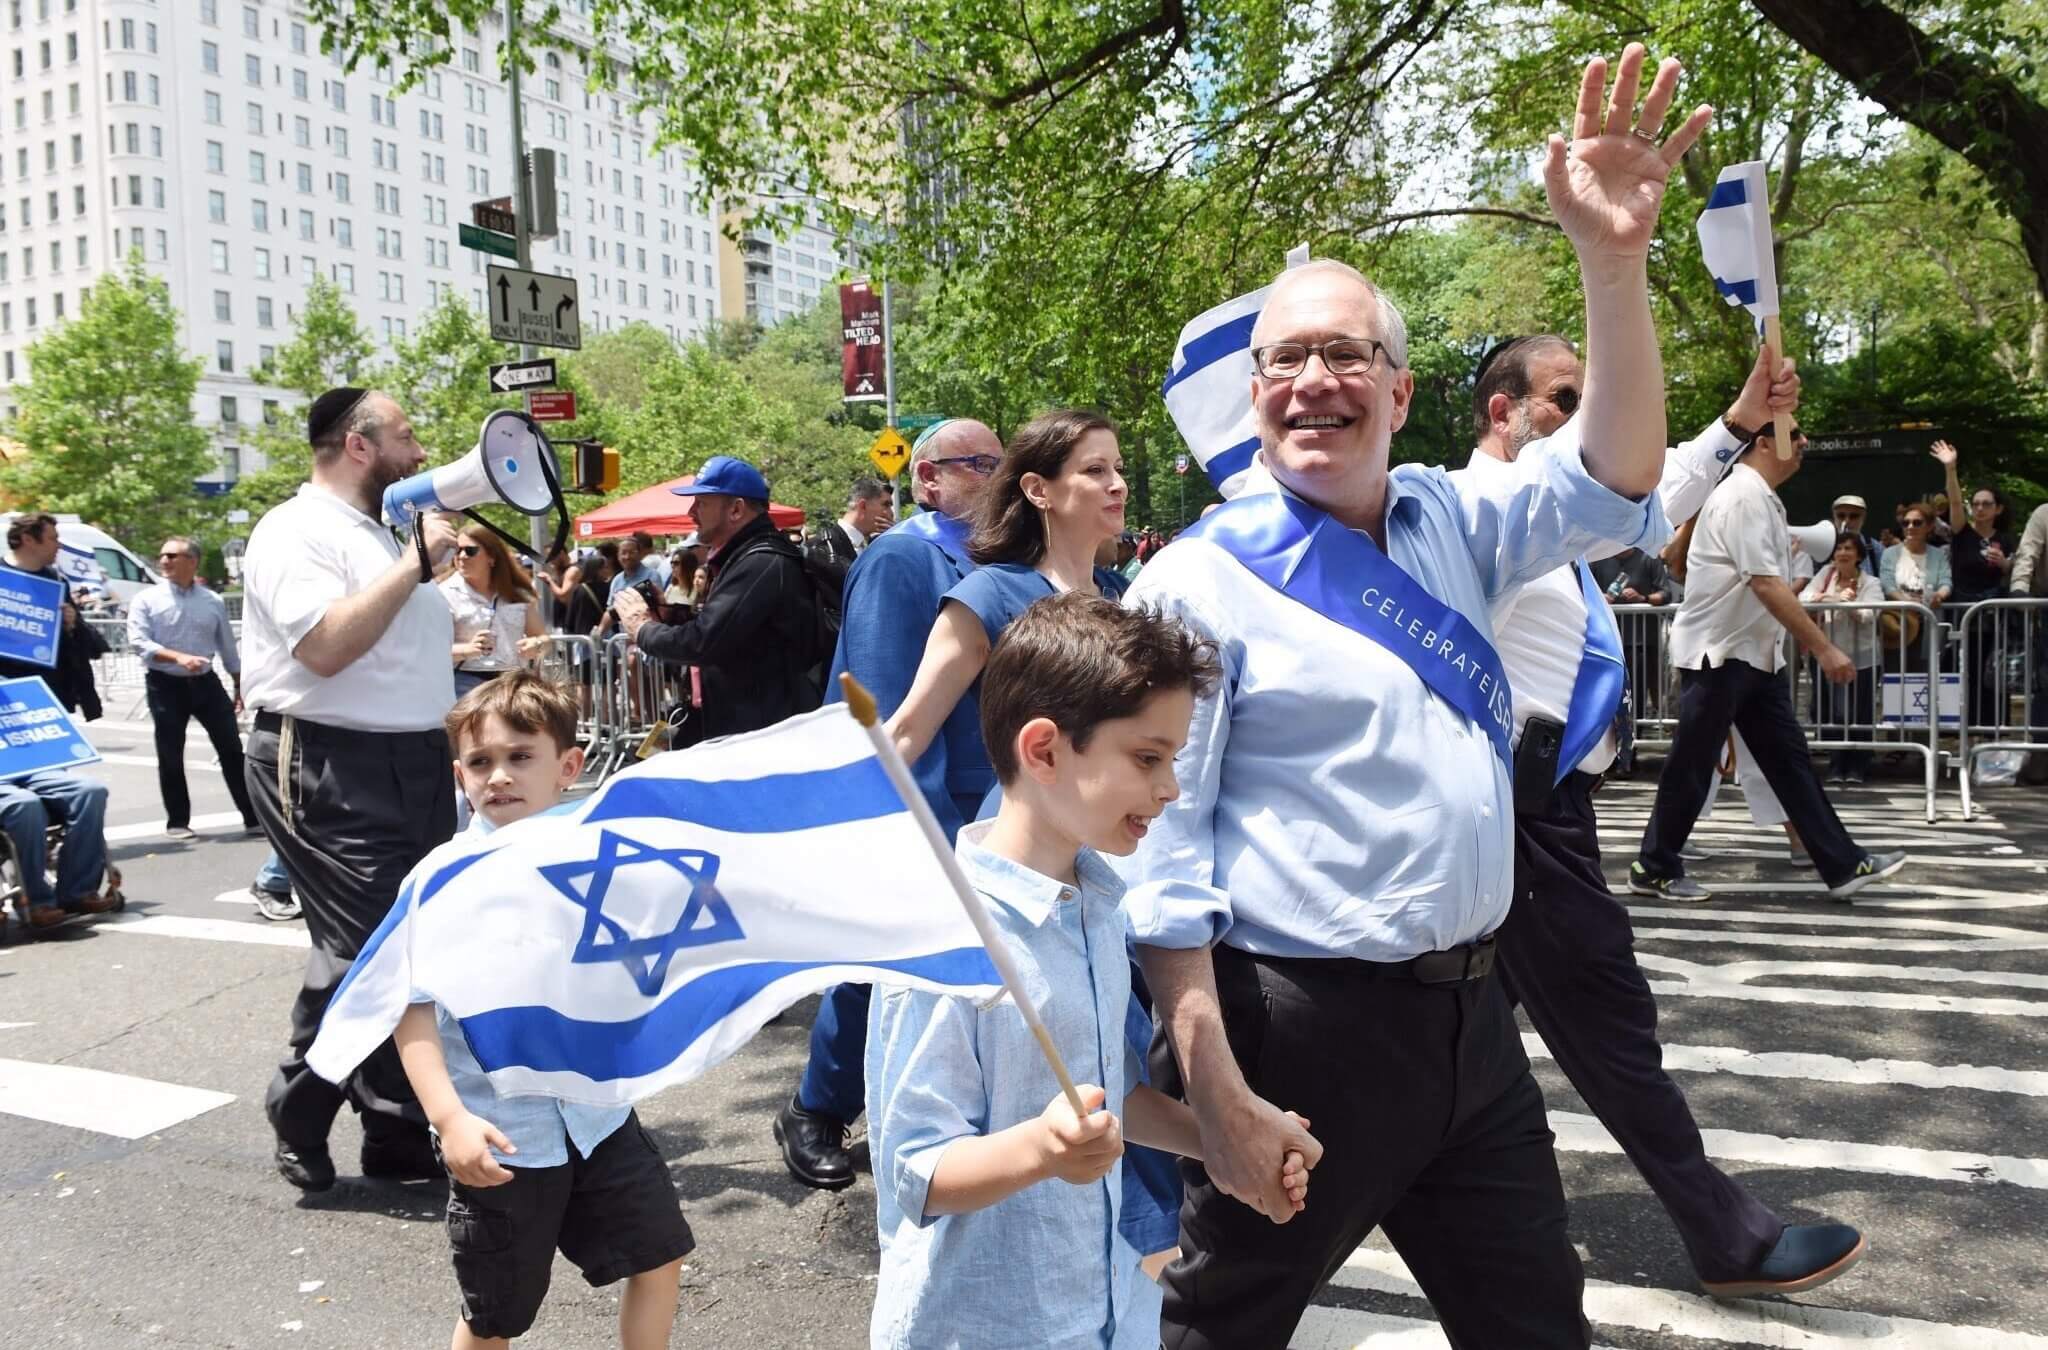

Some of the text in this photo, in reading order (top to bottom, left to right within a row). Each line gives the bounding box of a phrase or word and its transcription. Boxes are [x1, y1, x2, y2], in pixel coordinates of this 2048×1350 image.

[522, 312, 550, 327] BUSES
[494, 324, 518, 338] ONLY
[526, 328, 548, 340] ONLY
[844, 327, 874, 339] TILTED
[554, 332, 577, 345] ONLY
[856, 334, 880, 346] HEAD
[501, 367, 547, 384] ONE WAY
[1362, 588, 1492, 694] CELEBRATE
[4, 724, 71, 747] ISRAEL
